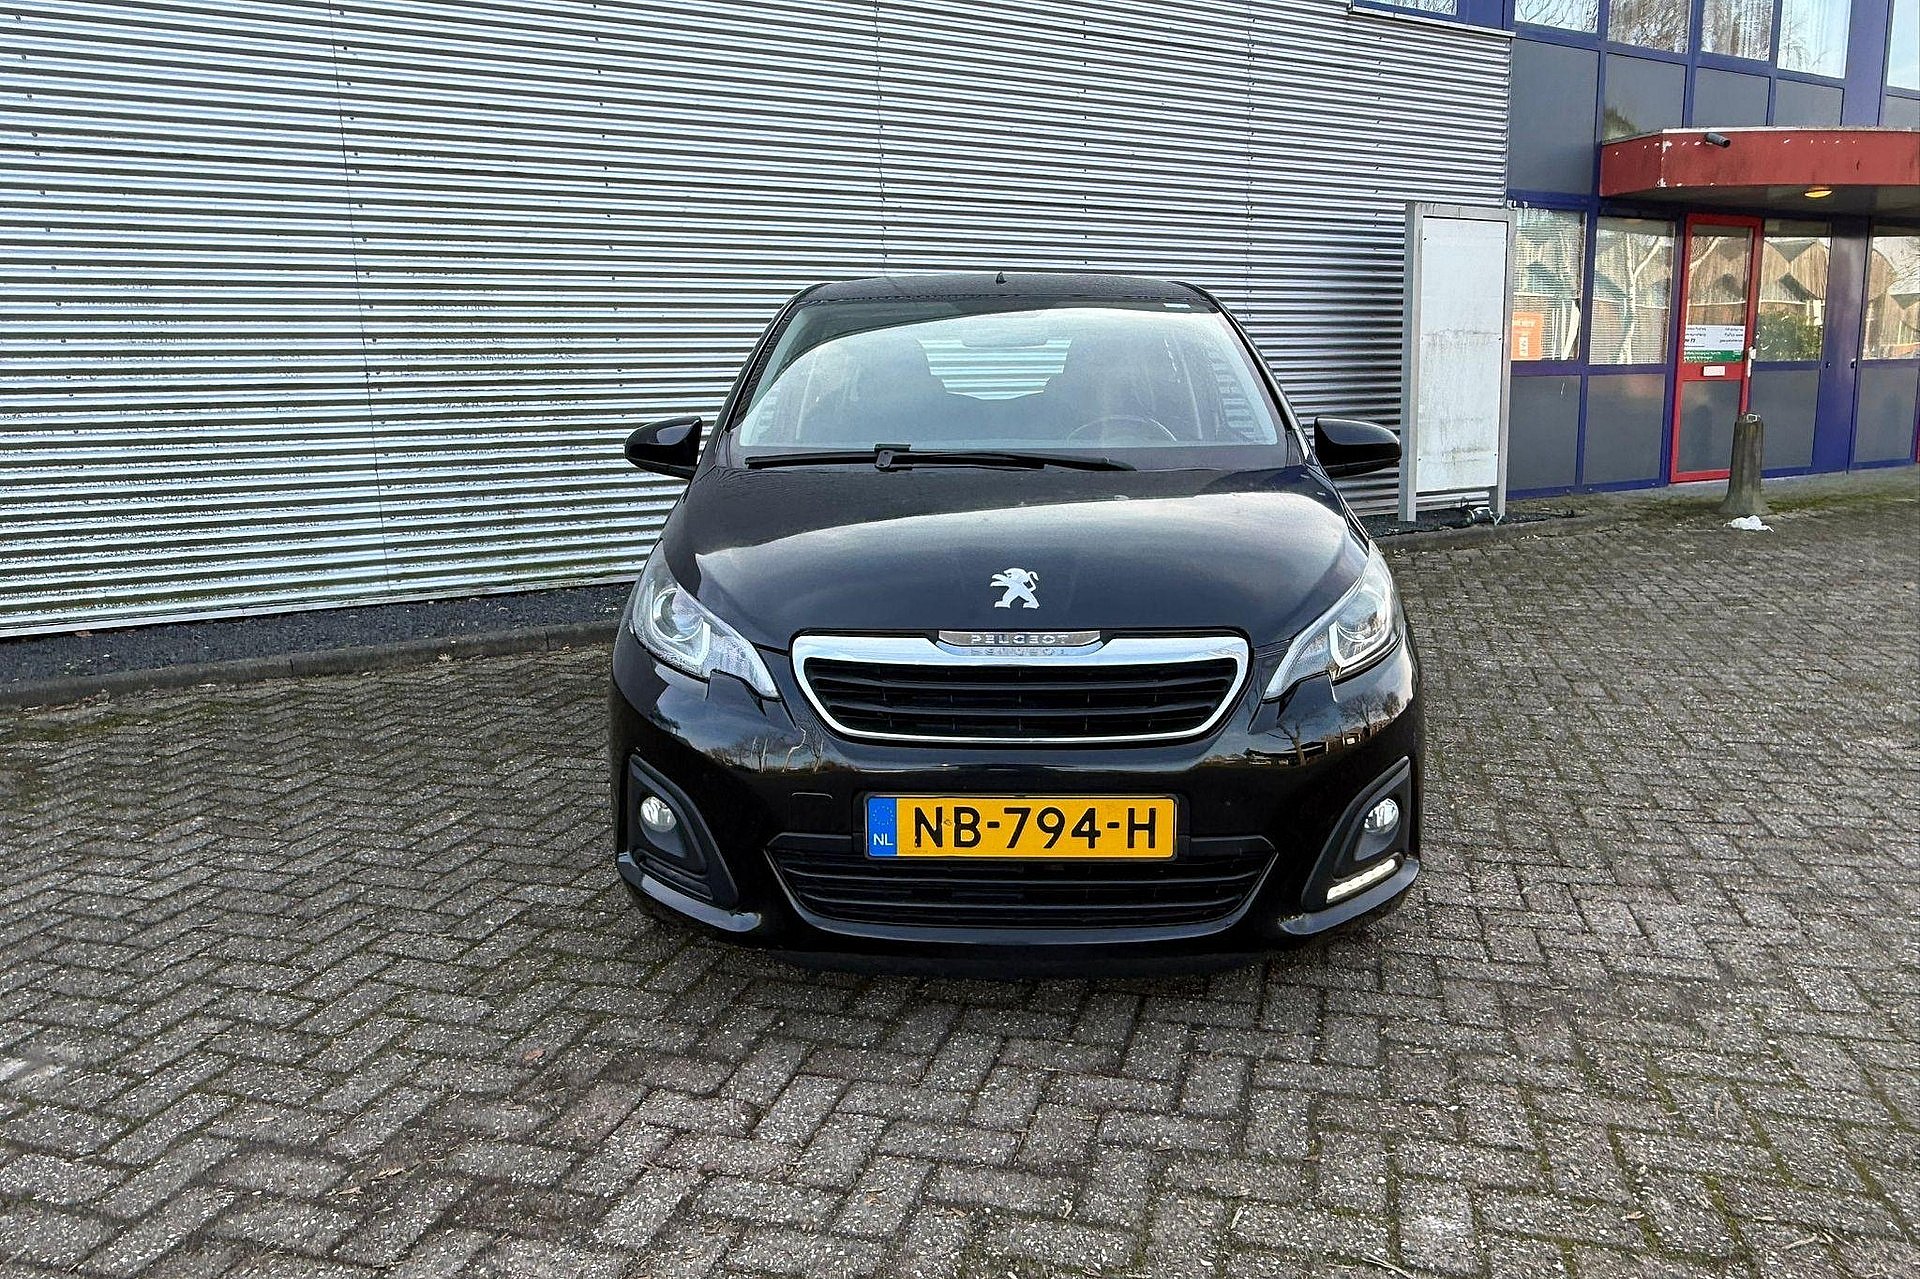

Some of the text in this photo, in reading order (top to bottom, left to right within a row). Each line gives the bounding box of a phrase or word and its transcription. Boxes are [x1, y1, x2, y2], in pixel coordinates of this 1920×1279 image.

[970, 634, 1069, 645] PEUGEOT
[914, 806, 1157, 849] NB-794-H
[873, 833, 894, 846] NL
